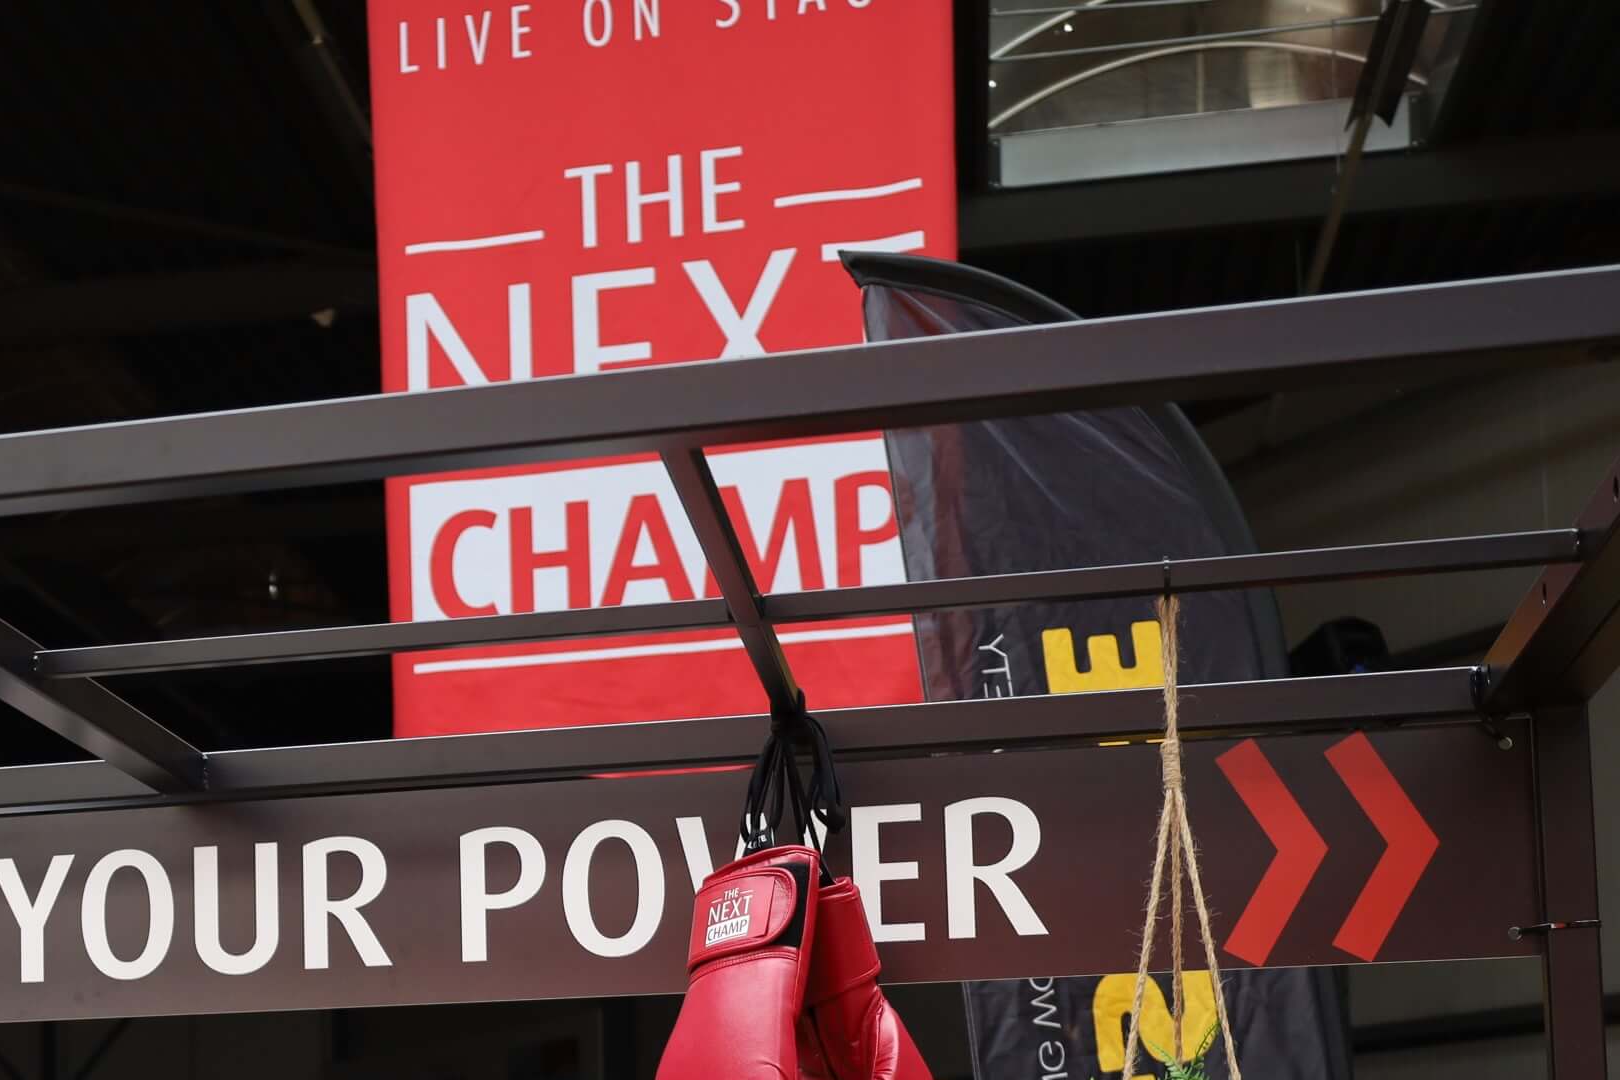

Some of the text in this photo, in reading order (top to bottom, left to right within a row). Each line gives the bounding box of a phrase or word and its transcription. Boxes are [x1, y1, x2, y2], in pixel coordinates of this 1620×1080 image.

[398, 4, 533, 74] LIVE
[583, 0, 661, 48] ON
[564, 146, 745, 249] THE
[428, 470, 902, 616] CHAMP
[707, 894, 754, 926] NEXT
[724, 887, 740, 900] THE
[707, 918, 749, 942] CHAMP
